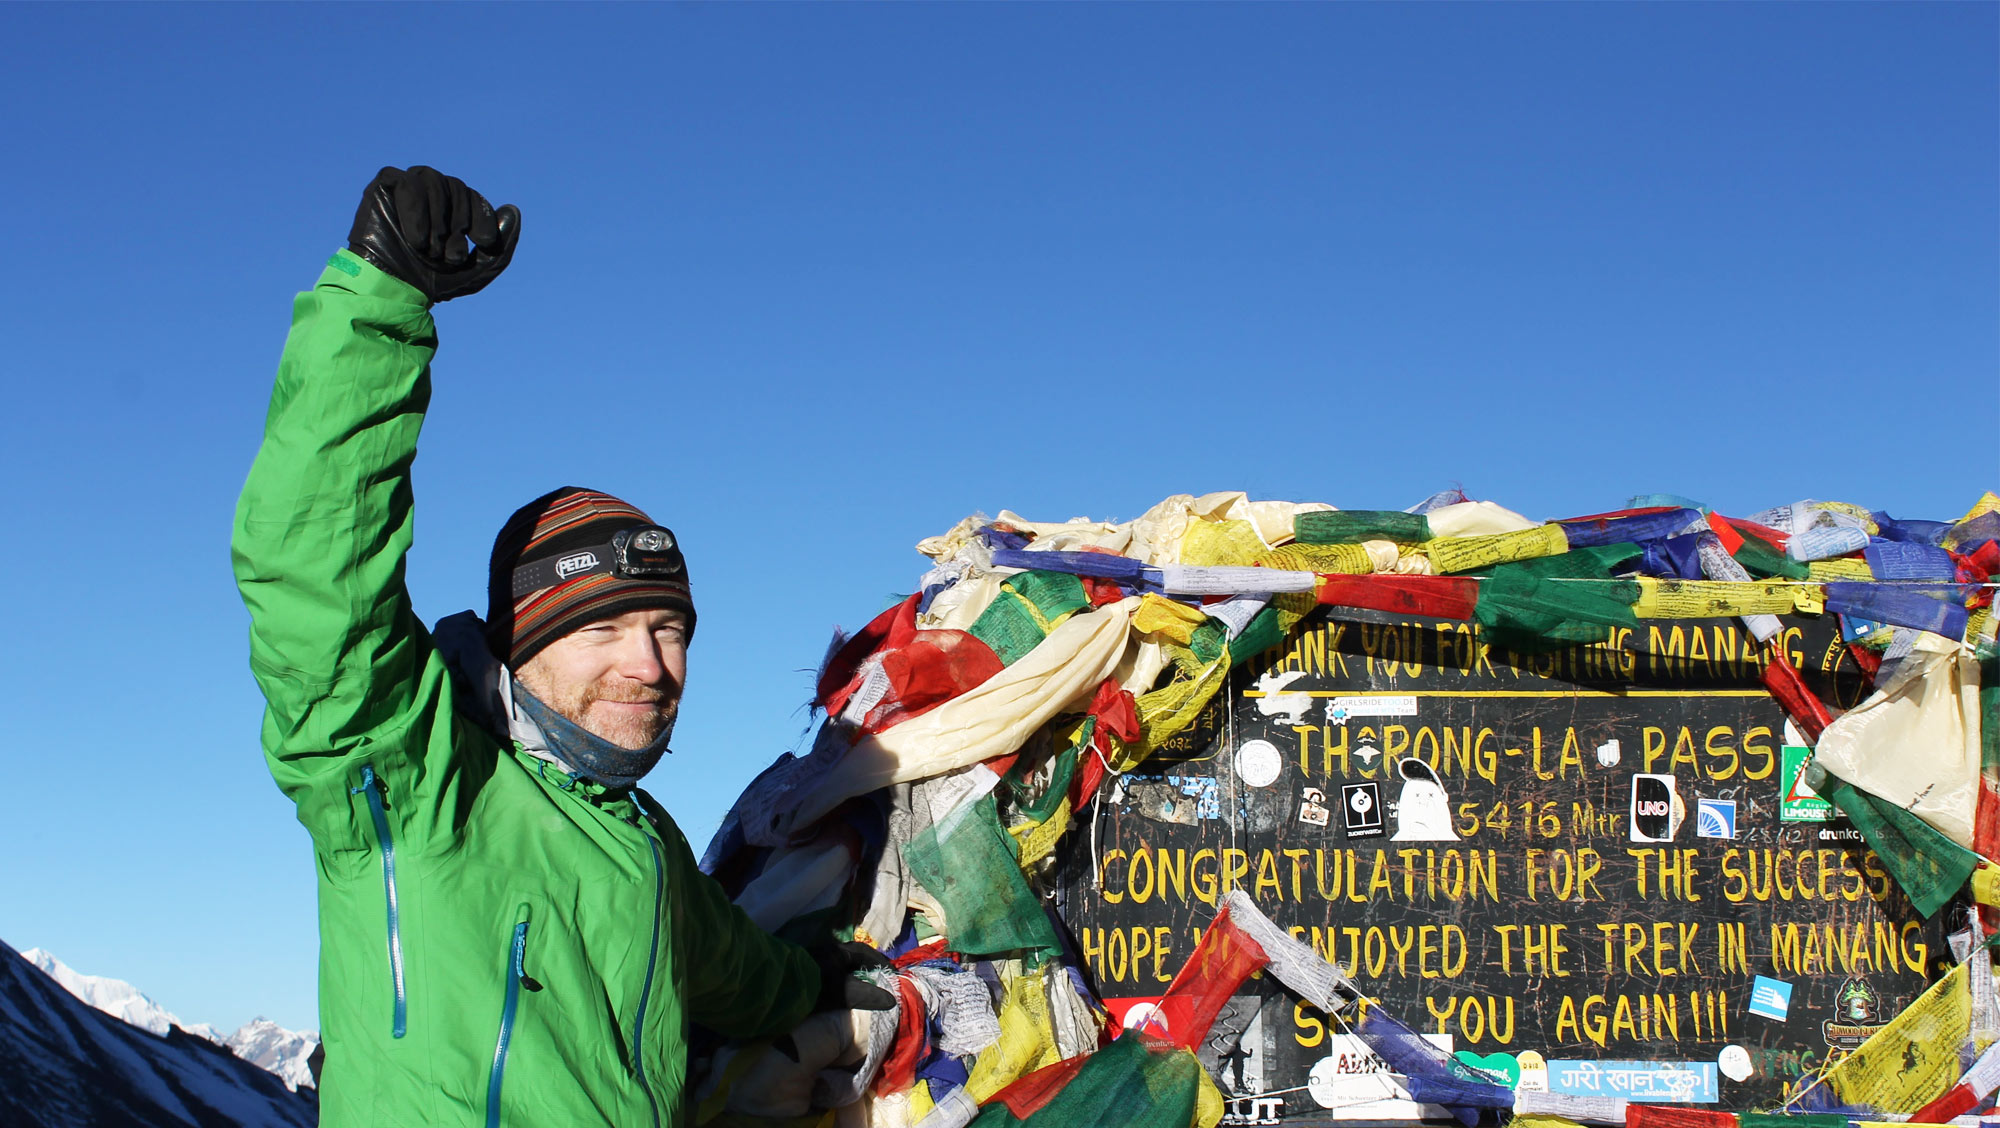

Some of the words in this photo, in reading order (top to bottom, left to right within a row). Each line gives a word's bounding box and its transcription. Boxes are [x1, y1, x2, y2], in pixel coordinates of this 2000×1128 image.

[558, 553, 600, 579] PETZL
[1361, 622, 1423, 679] YOU
[1436, 622, 1497, 678] FOR
[1339, 698, 1415, 707] GIRLSRIDETOO.DE
[1642, 725, 1774, 781] PASS
[1458, 800, 1562, 840] 5416
[1637, 800, 1669, 816] UNO
[1784, 807, 1833, 818] LIMOUSIN
[1098, 848, 1498, 905] CONGRATULATION
[1526, 848, 1605, 902] FOR
[1627, 848, 1701, 902] THE
[1721, 848, 1889, 902] SUCCESS
[1083, 926, 1173, 982] HOPE
[1494, 923, 1571, 978] THE
[1597, 922, 1699, 977] TREK
[1717, 922, 1748, 975] IN
[1771, 921, 1927, 979] MANANG
[1426, 996, 1515, 1045] YOU
[1560, 1062, 1604, 1091] गरी
